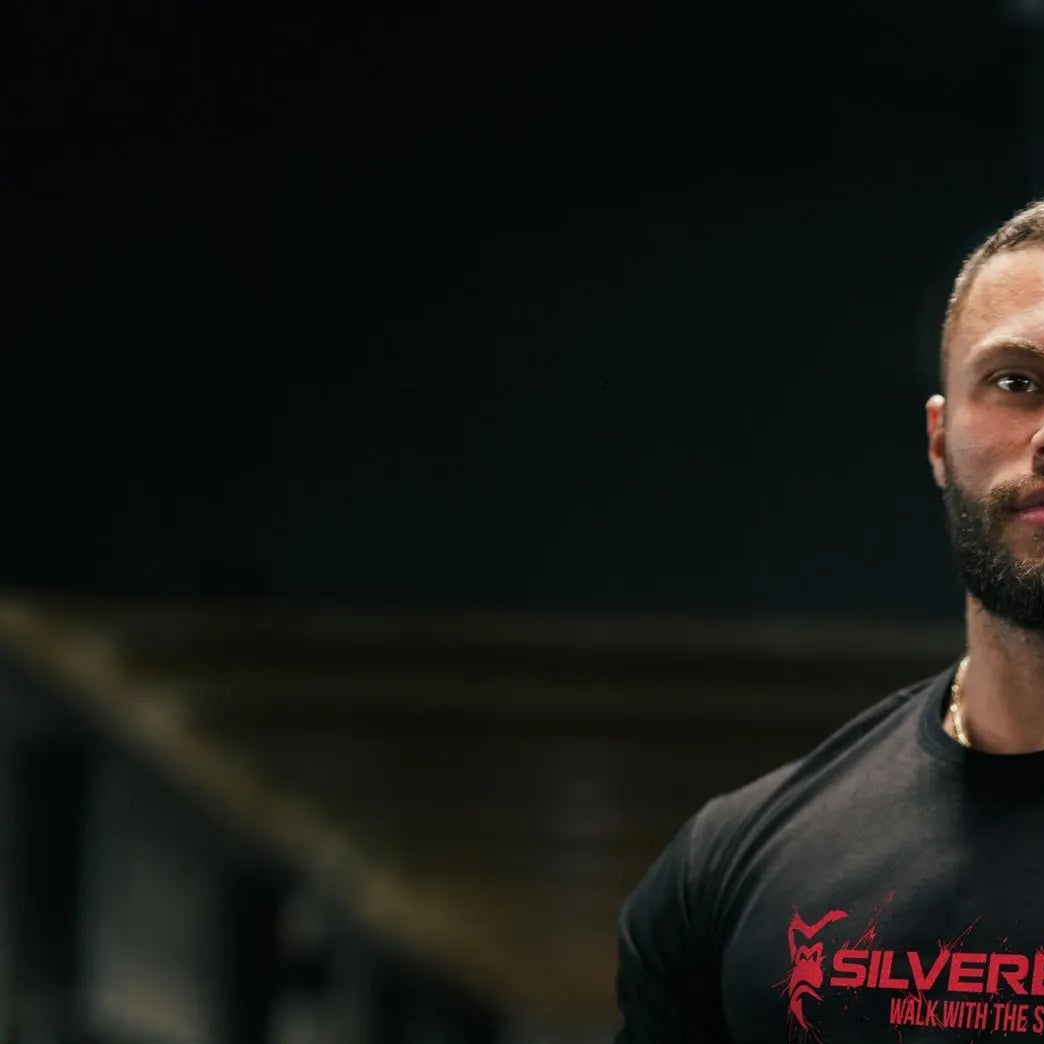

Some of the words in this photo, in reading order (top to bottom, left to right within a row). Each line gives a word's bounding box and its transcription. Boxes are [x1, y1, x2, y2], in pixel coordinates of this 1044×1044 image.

[889, 998, 938, 1027] WALK
[943, 1001, 988, 1030] WITH
[993, 1003, 1029, 1033] THE
